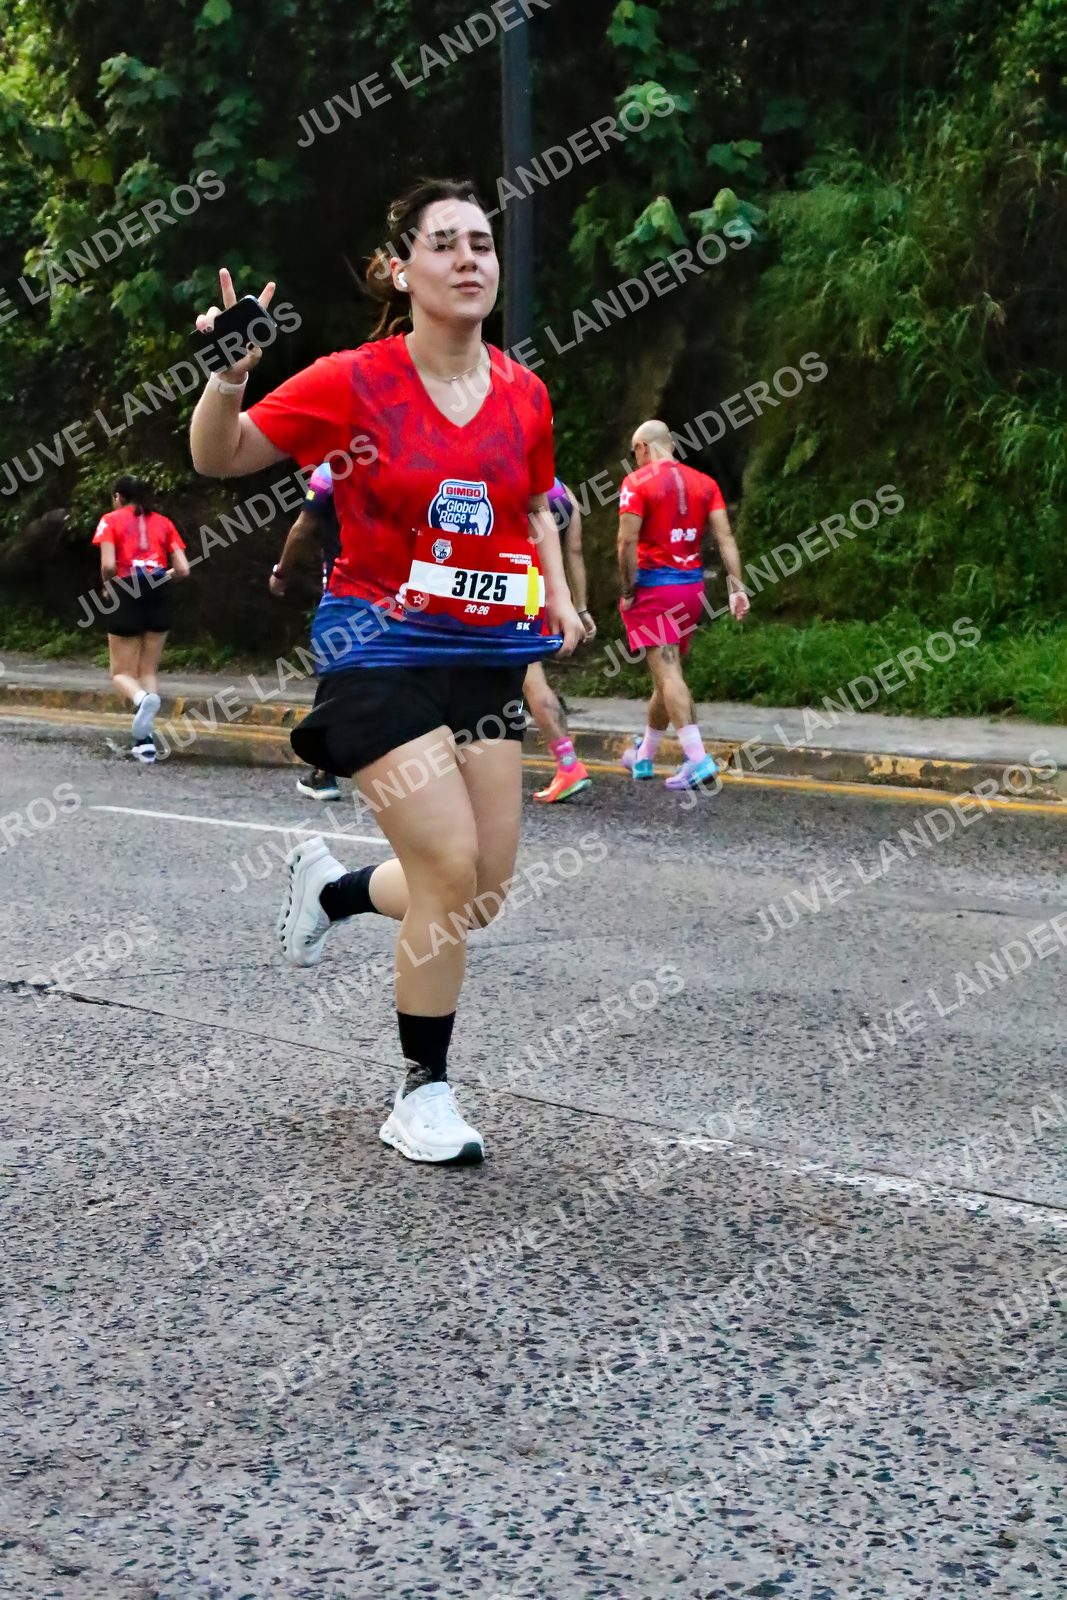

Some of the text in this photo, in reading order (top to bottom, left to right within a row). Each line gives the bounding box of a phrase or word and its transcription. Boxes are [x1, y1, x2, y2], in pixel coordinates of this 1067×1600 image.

[446, 487, 481, 497] BIMBO
[446, 500, 479, 514] Global
[439, 510, 467, 524] Race
[451, 570, 508, 602] 3125
[516, 622, 531, 631] 5K
